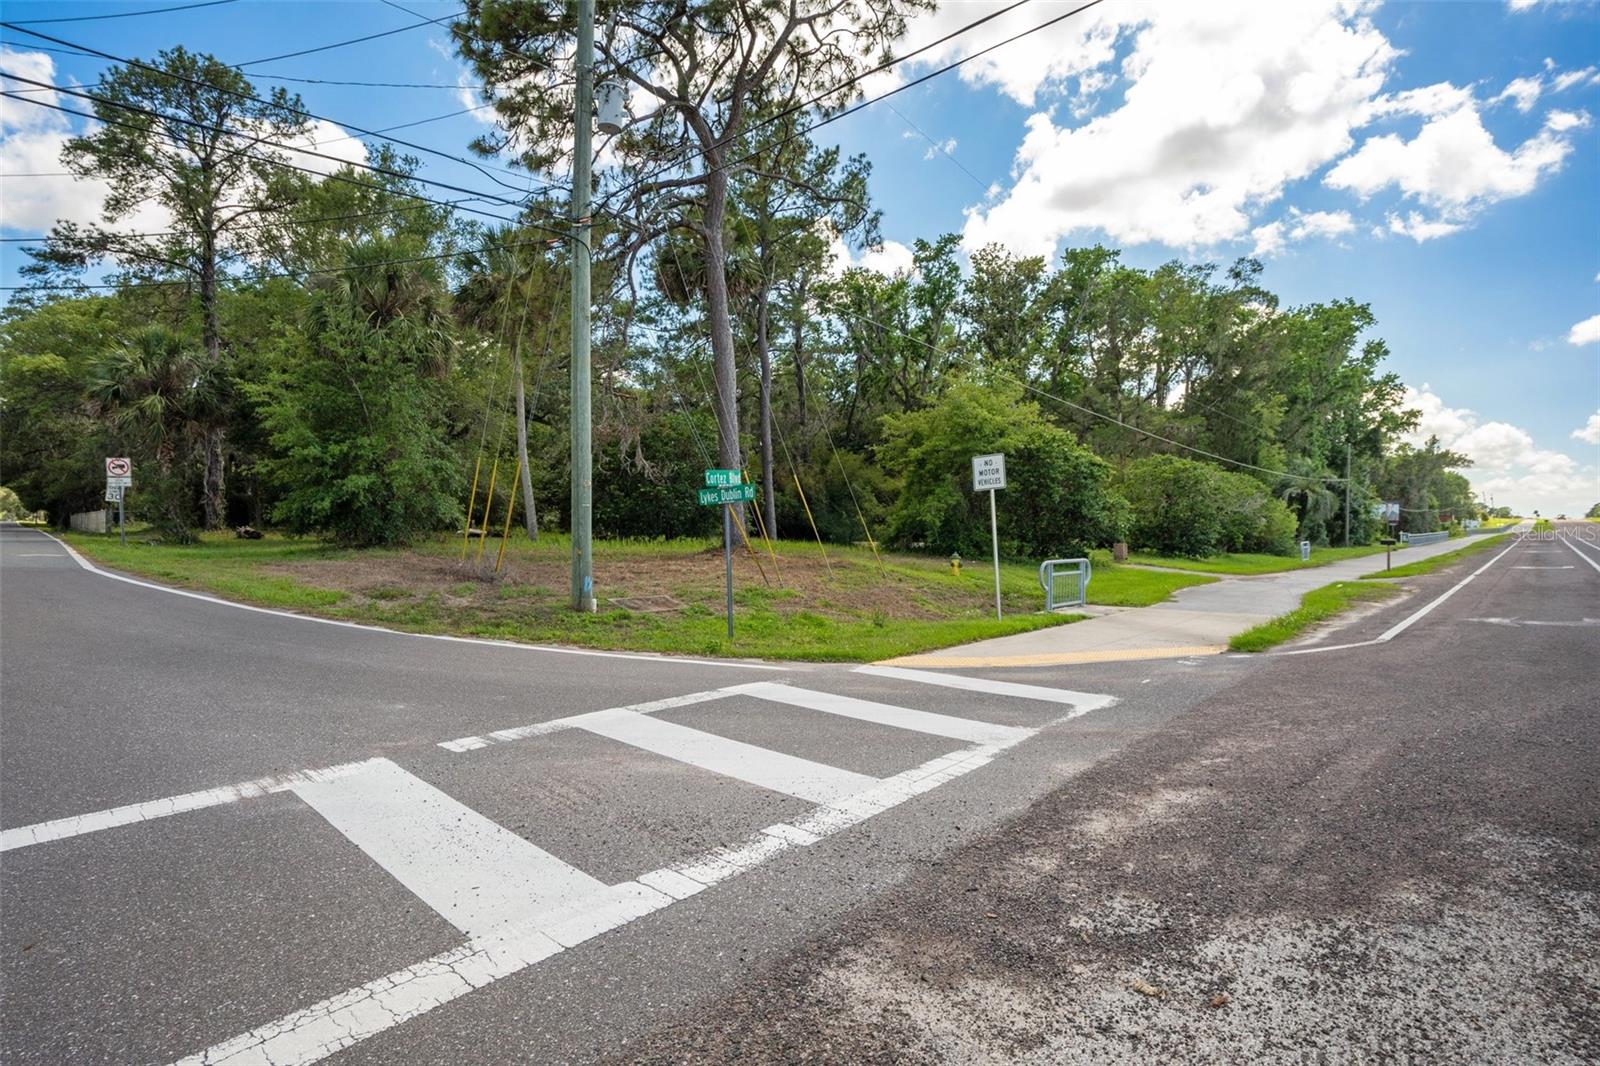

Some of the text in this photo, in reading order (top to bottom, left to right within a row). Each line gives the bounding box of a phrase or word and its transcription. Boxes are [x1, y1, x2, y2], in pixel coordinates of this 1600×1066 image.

[978, 468, 1000, 476] MOTOR
[705, 472, 727, 484] Cortez
[978, 477, 1002, 486] VEHICLES
[700, 486, 754, 505] Lykes Dublin Rd
